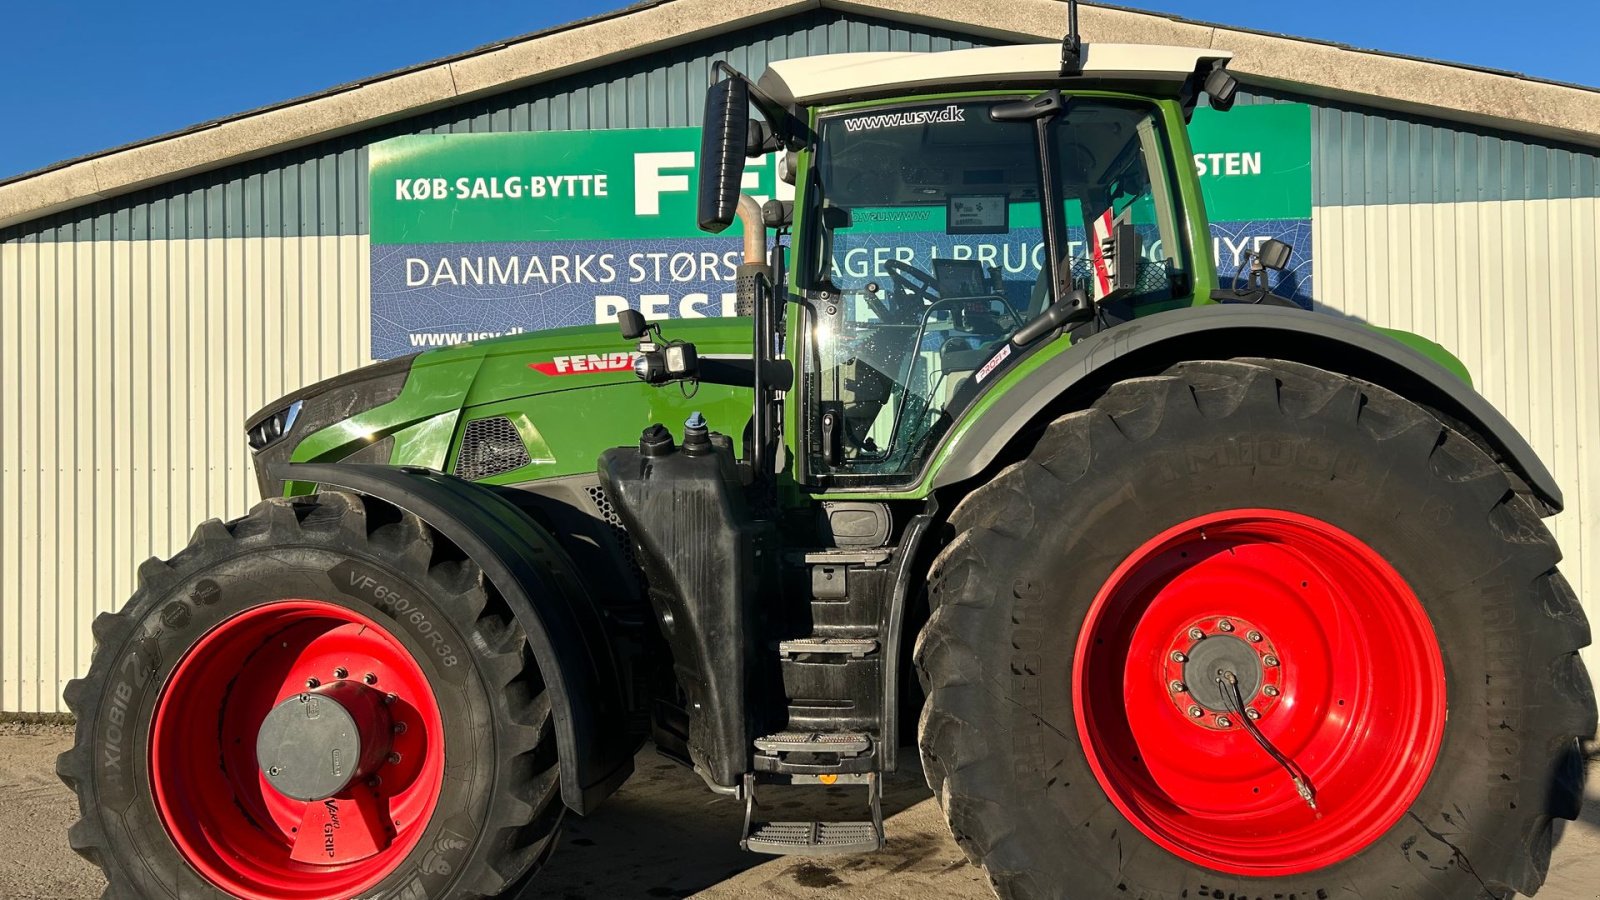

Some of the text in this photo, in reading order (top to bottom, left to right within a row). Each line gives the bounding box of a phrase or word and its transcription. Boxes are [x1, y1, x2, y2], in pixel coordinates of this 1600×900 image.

[845, 105, 966, 132] www.usv.dk
[406, 254, 616, 287] DANMARKS
[323, 823, 335, 858] GRIP
